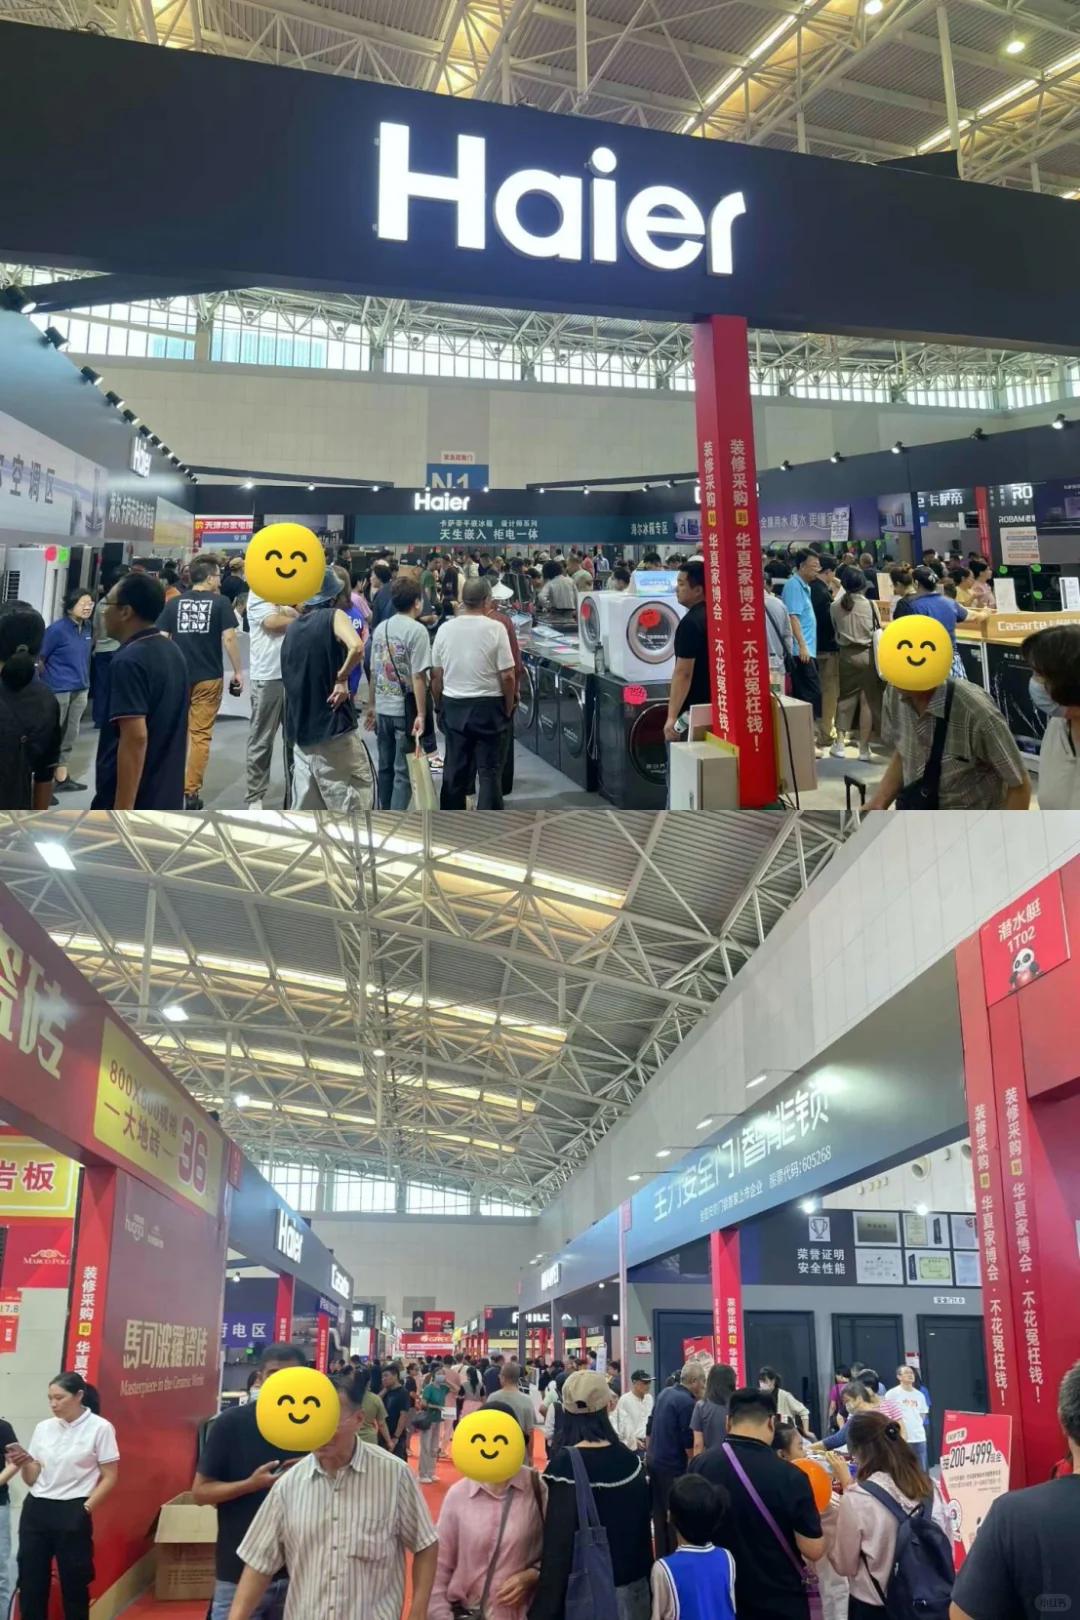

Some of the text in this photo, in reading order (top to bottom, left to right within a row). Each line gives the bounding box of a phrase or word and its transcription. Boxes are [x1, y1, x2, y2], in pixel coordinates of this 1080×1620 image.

[375, 121, 747, 276] Haier
[0, 453, 55, 504] 空调区
[414, 491, 470, 511] Haier
[928, 492, 963, 507] 卡萨帝
[440, 529, 539, 541] 天生嵌入 柜电一体
[997, 620, 1048, 632] Casarte
[998, 898, 1041, 942] 潜水艇
[1008, 925, 1036, 953] 1T02
[177, 1115, 209, 1196] 36
[797, 1248, 845, 1262] 荣誉证明
[798, 1262, 846, 1275] 安全性能
